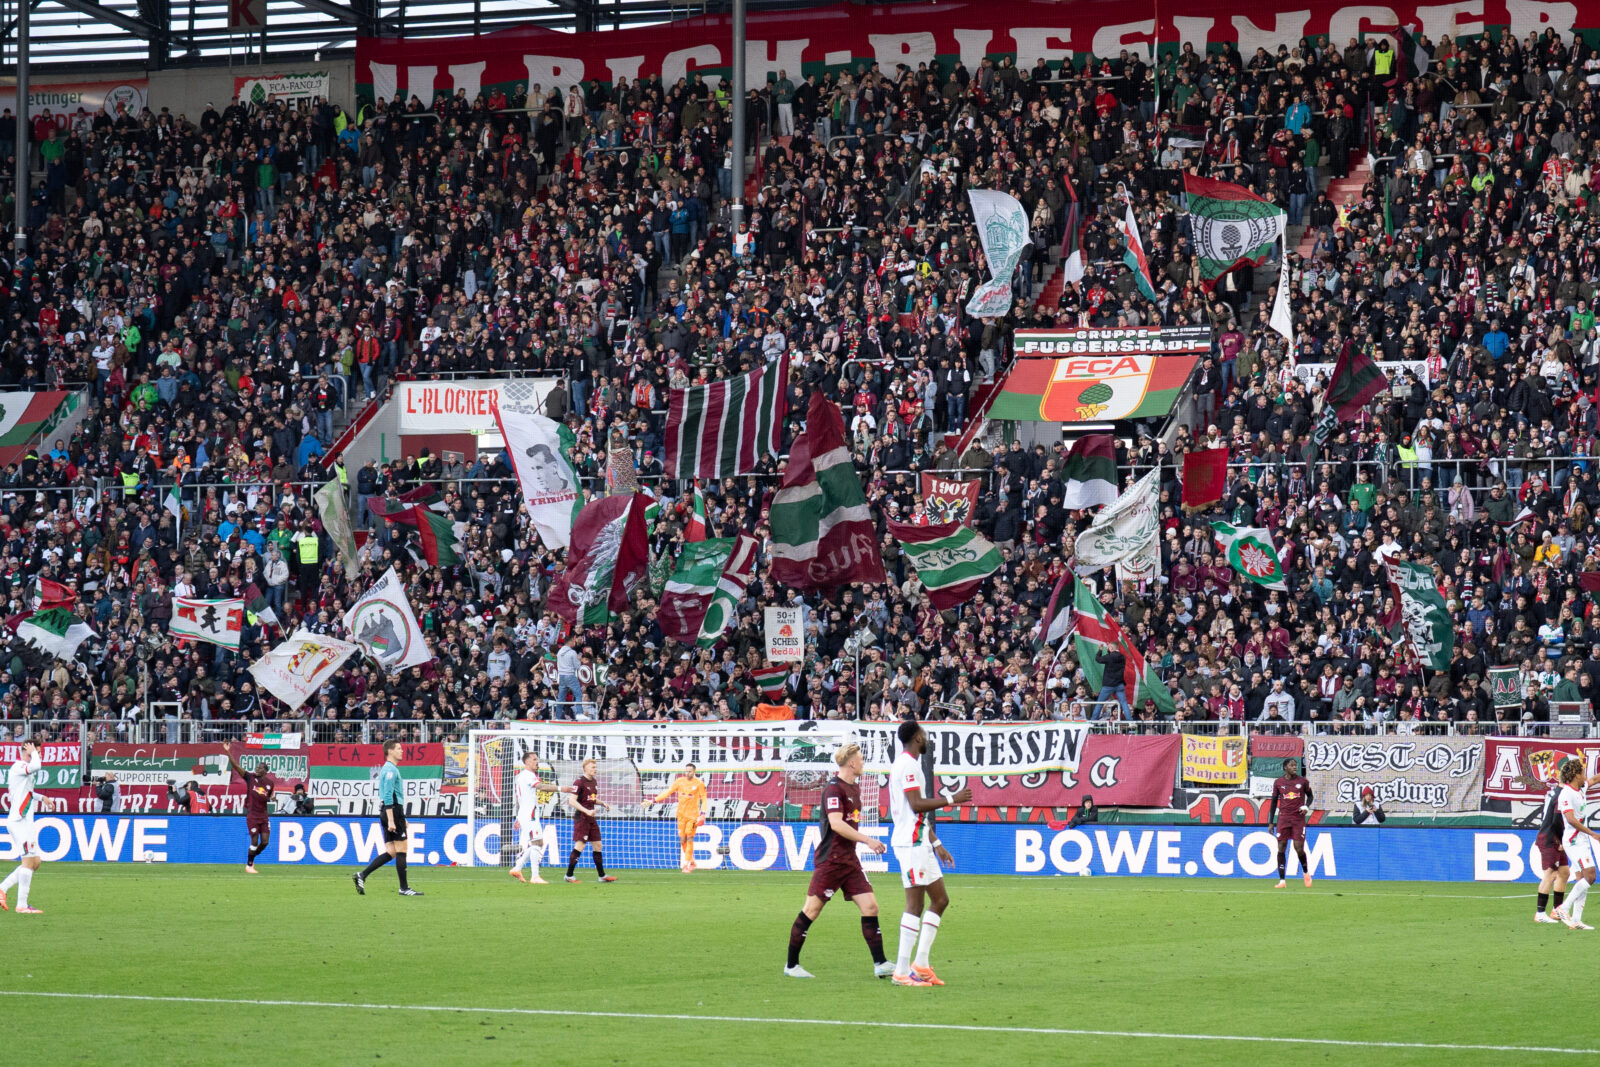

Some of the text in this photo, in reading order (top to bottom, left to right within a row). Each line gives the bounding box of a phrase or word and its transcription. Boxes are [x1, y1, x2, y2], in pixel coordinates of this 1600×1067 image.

[232, 0, 259, 27] K
[28, 90, 84, 108] ettinger
[1075, 328, 1149, 340] GRUPPE
[1023, 339, 1199, 354] FUGGERSTADT
[1065, 356, 1141, 376] FCA
[931, 479, 971, 496] 1907
[776, 611, 797, 620] 50+1
[771, 647, 788, 656] Red
[517, 727, 608, 762] SIMON
[850, 728, 1082, 767] UNERGESSEN
[1186, 737, 1217, 751] Frei
[101, 747, 180, 768] fanfahrt
[327, 746, 361, 762] FCA
[240, 754, 307, 773] CONCORDIA
[56, 768, 80, 786] 07
[114, 771, 169, 784] SUPPORTER
[1184, 767, 1238, 782] Bayern
[1015, 829, 1337, 876] BOWE.COM
